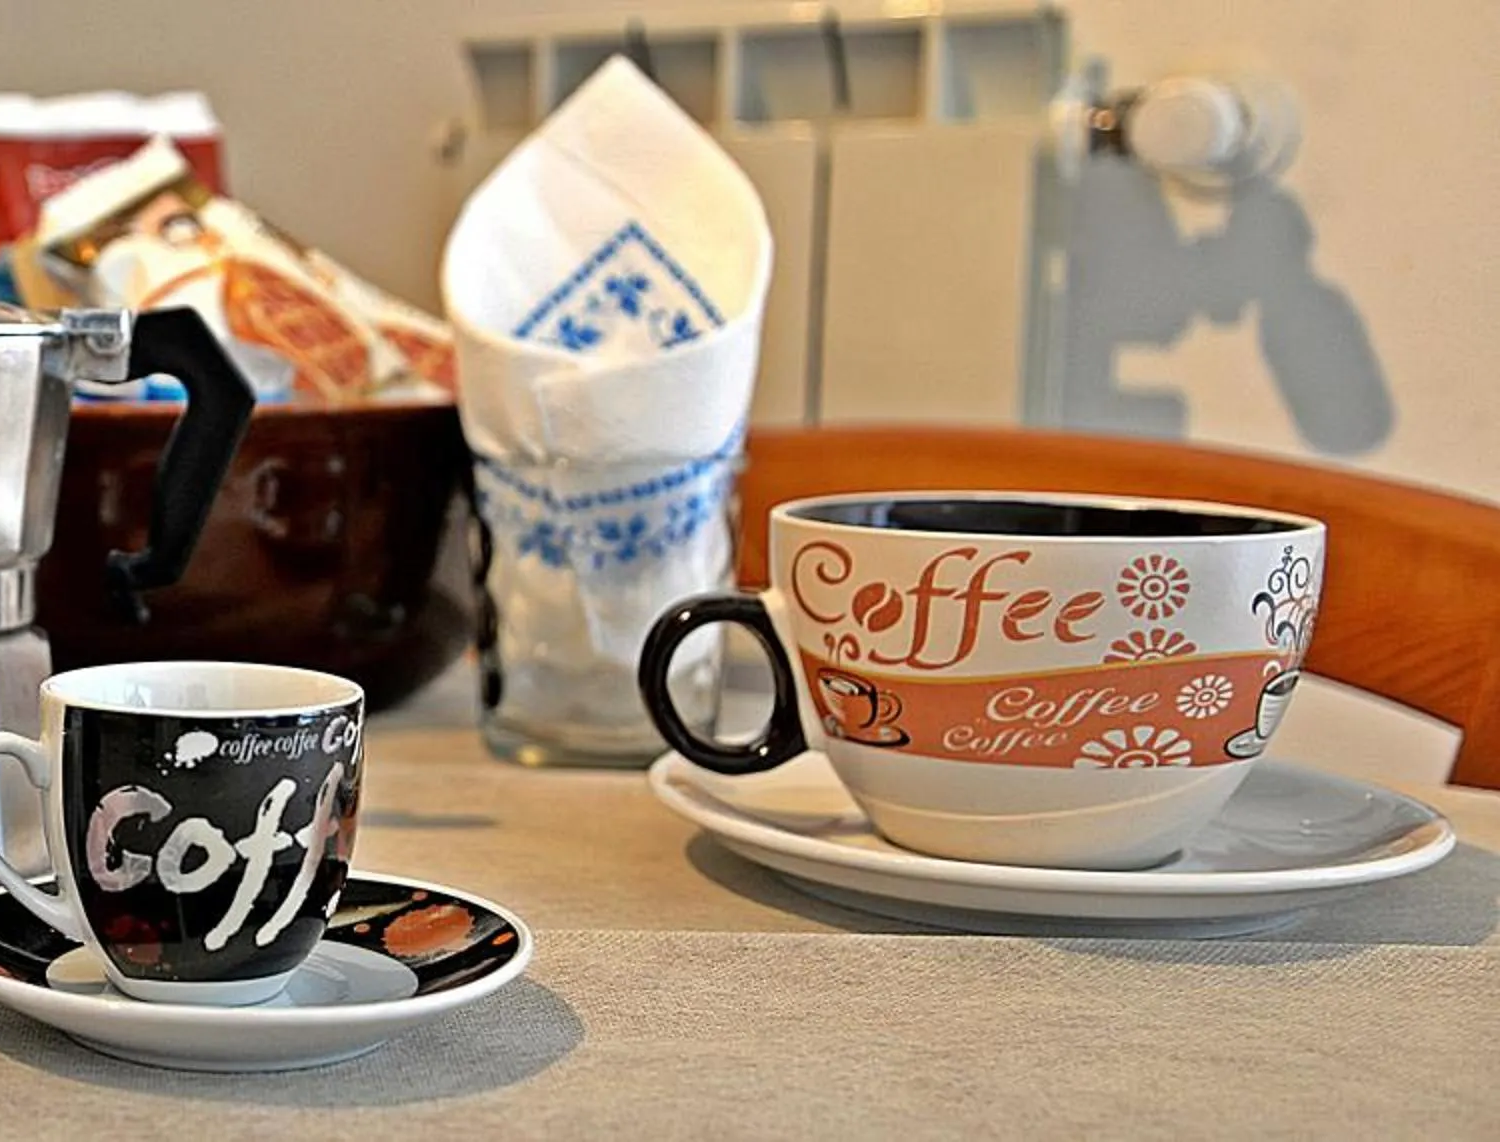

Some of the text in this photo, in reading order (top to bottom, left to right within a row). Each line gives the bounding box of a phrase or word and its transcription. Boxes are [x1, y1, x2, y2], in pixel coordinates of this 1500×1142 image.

[792, 540, 1105, 670] Coffee
[986, 686, 1160, 728] Coffee
[219, 733, 273, 763] coffee
[274, 729, 319, 760] coffee
[942, 724, 1070, 755] Coffee
